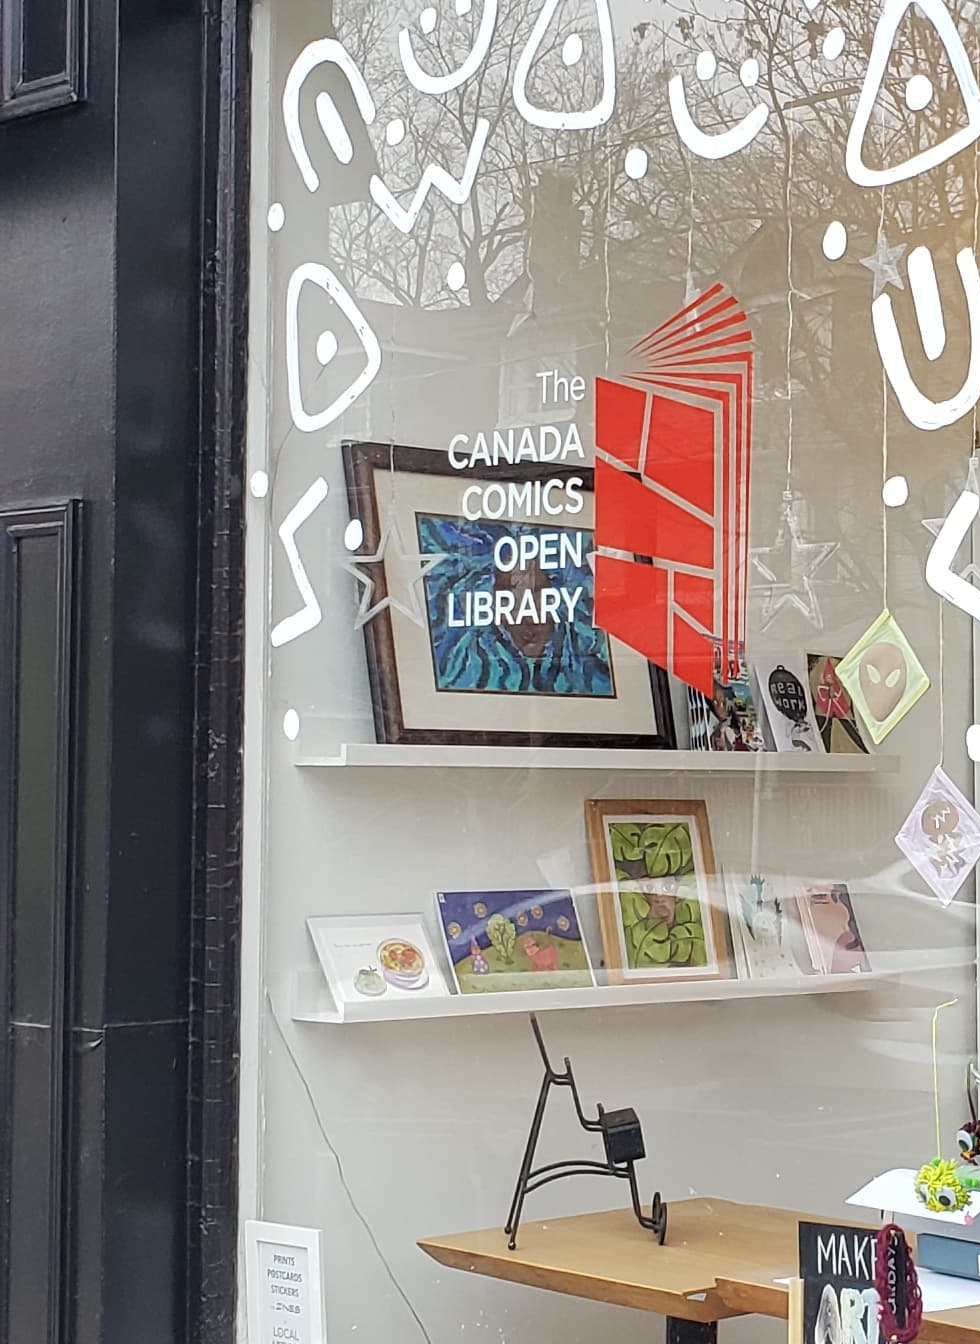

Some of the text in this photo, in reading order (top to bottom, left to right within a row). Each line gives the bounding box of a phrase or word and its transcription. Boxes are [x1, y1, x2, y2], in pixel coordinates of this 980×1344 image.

[536, 369, 585, 403] The
[448, 424, 584, 470] CANADA
[462, 477, 583, 521] COMICS
[494, 532, 582, 572] OPEN
[448, 587, 583, 627] LIBRARY
[267, 1268, 302, 1283] POSTCARDS
[273, 1254, 295, 1266] PRINTS
[271, 1284, 299, 1298] STICKERS
[273, 1326, 300, 1341] LOCAL
